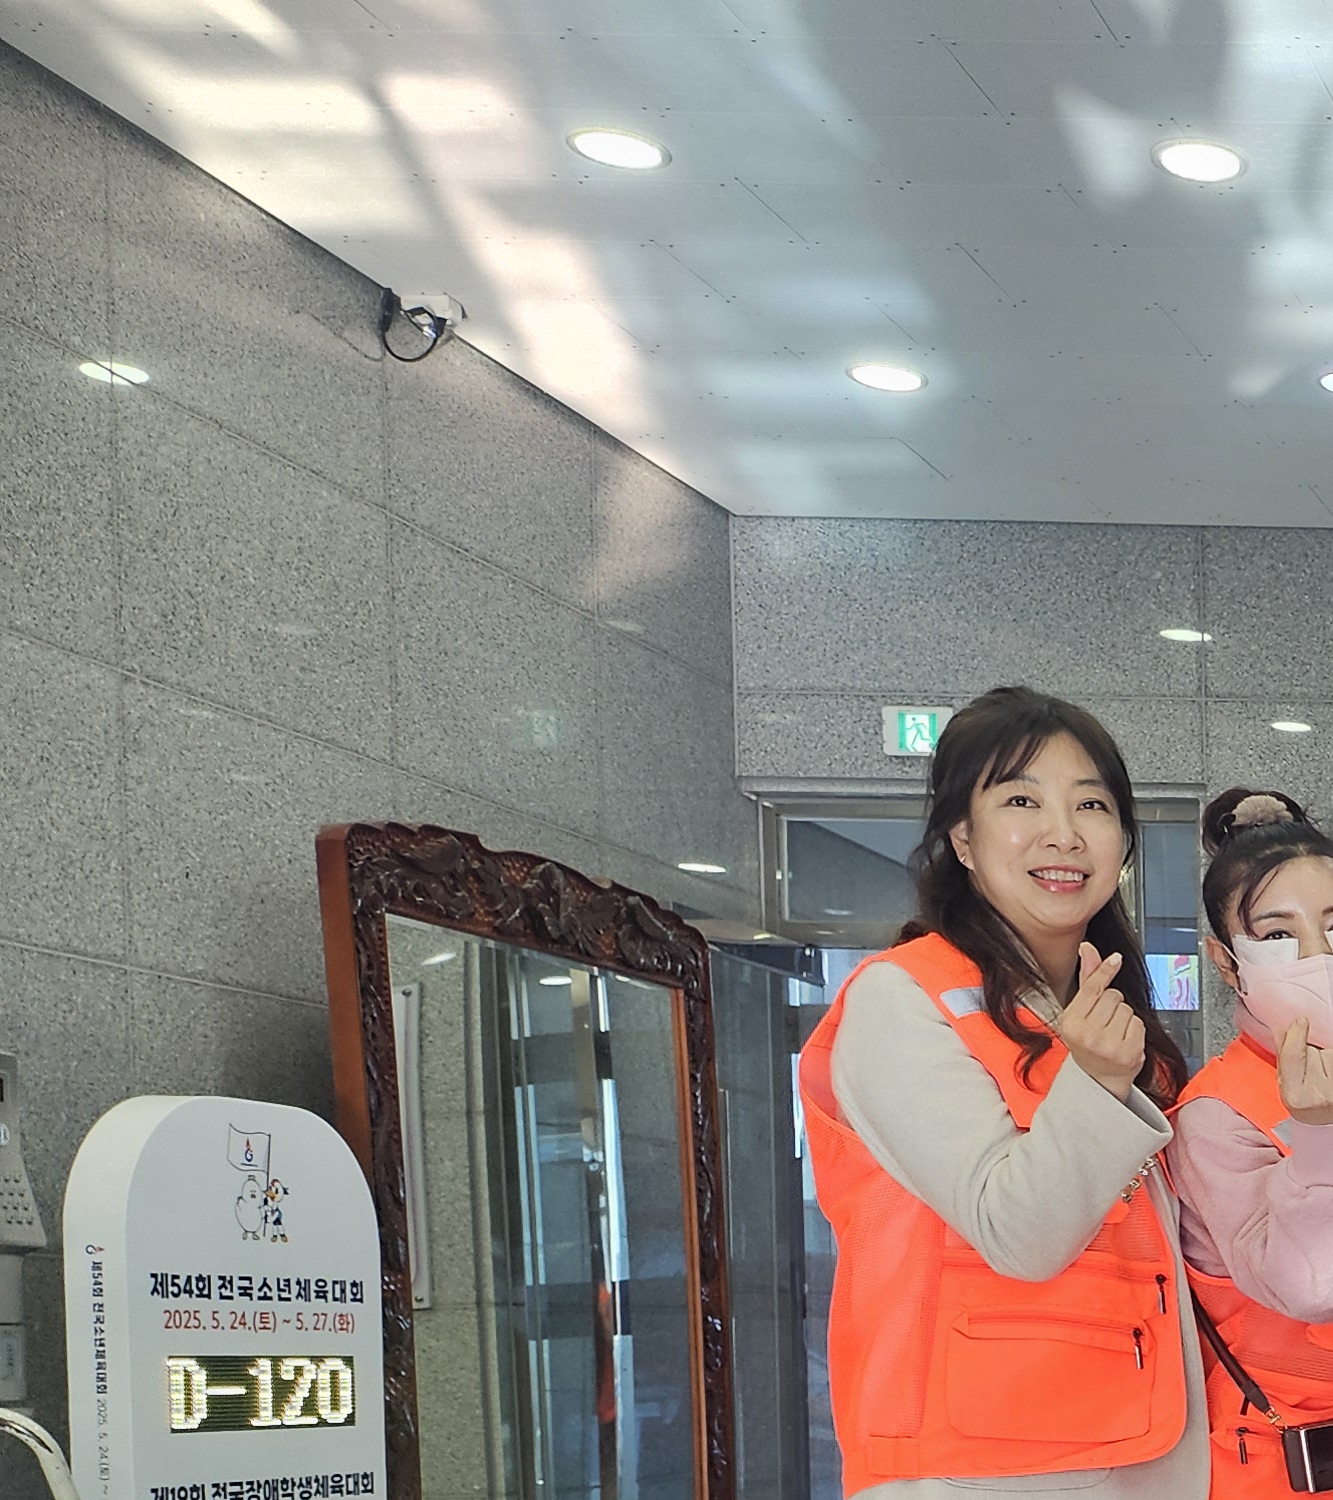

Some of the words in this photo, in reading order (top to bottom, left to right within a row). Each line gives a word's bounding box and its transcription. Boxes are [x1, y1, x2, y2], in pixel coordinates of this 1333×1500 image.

[150, 1273, 212, 1300] 제54회
[218, 1276, 364, 1304] 전국소년체육대회
[163, 1310, 206, 1330] 2025.
[212, 1311, 224, 1330] 5.
[230, 1311, 277, 1333] 24.(토)
[296, 1312, 308, 1331] 5.
[313, 1313, 355, 1333] 27.(화)
[166, 1358, 352, 1429] D-120
